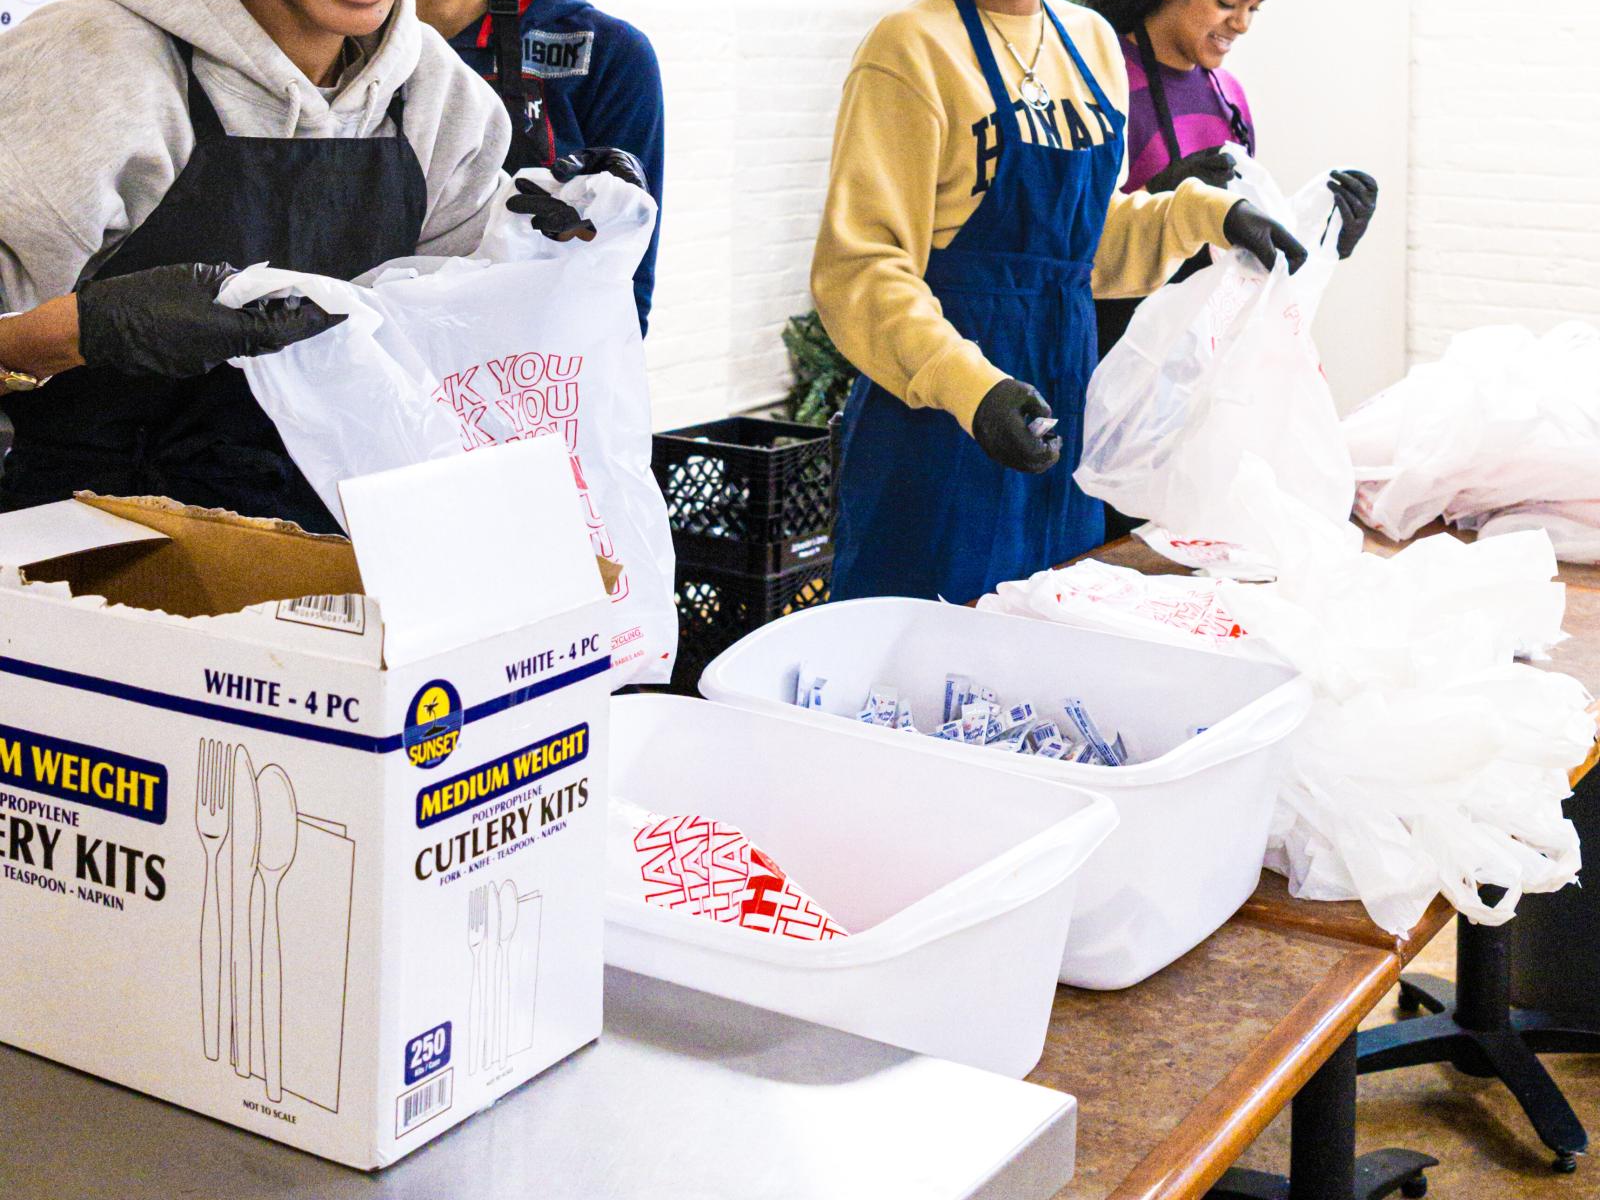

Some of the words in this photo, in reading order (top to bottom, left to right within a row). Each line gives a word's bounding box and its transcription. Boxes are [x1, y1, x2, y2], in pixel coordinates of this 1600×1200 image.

[487, 352, 583, 394] YOU
[496, 383, 579, 432] YOU
[505, 650, 554, 683] WHITE
[569, 642, 577, 660] 4
[581, 634, 600, 657] PC
[204, 668, 281, 707] WHITE
[305, 691, 318, 715] 4
[326, 693, 360, 723] PC
[409, 730, 459, 766] SUNSET
[31, 745, 160, 812] WEIGHT
[420, 762, 510, 821] MEDIUM
[513, 729, 586, 780] WEIGHT
[415, 803, 533, 881] CUTLERY
[541, 777, 589, 826] KITS
[472, 785, 543, 824] POLYPROPYLENE
[76, 833, 166, 902] KITS
[439, 870, 462, 886] FORK
[468, 856, 491, 873] KNIFE
[497, 837, 535, 860] TEASPOON
[541, 821, 568, 839] NAPKIN
[3, 864, 66, 895] TEASPOON
[77, 886, 124, 912] NAPKIN
[409, 1027, 446, 1069] 250
[243, 1099, 259, 1112] NOT
[260, 1105, 272, 1116] TO
[273, 1109, 297, 1125] SCALE
